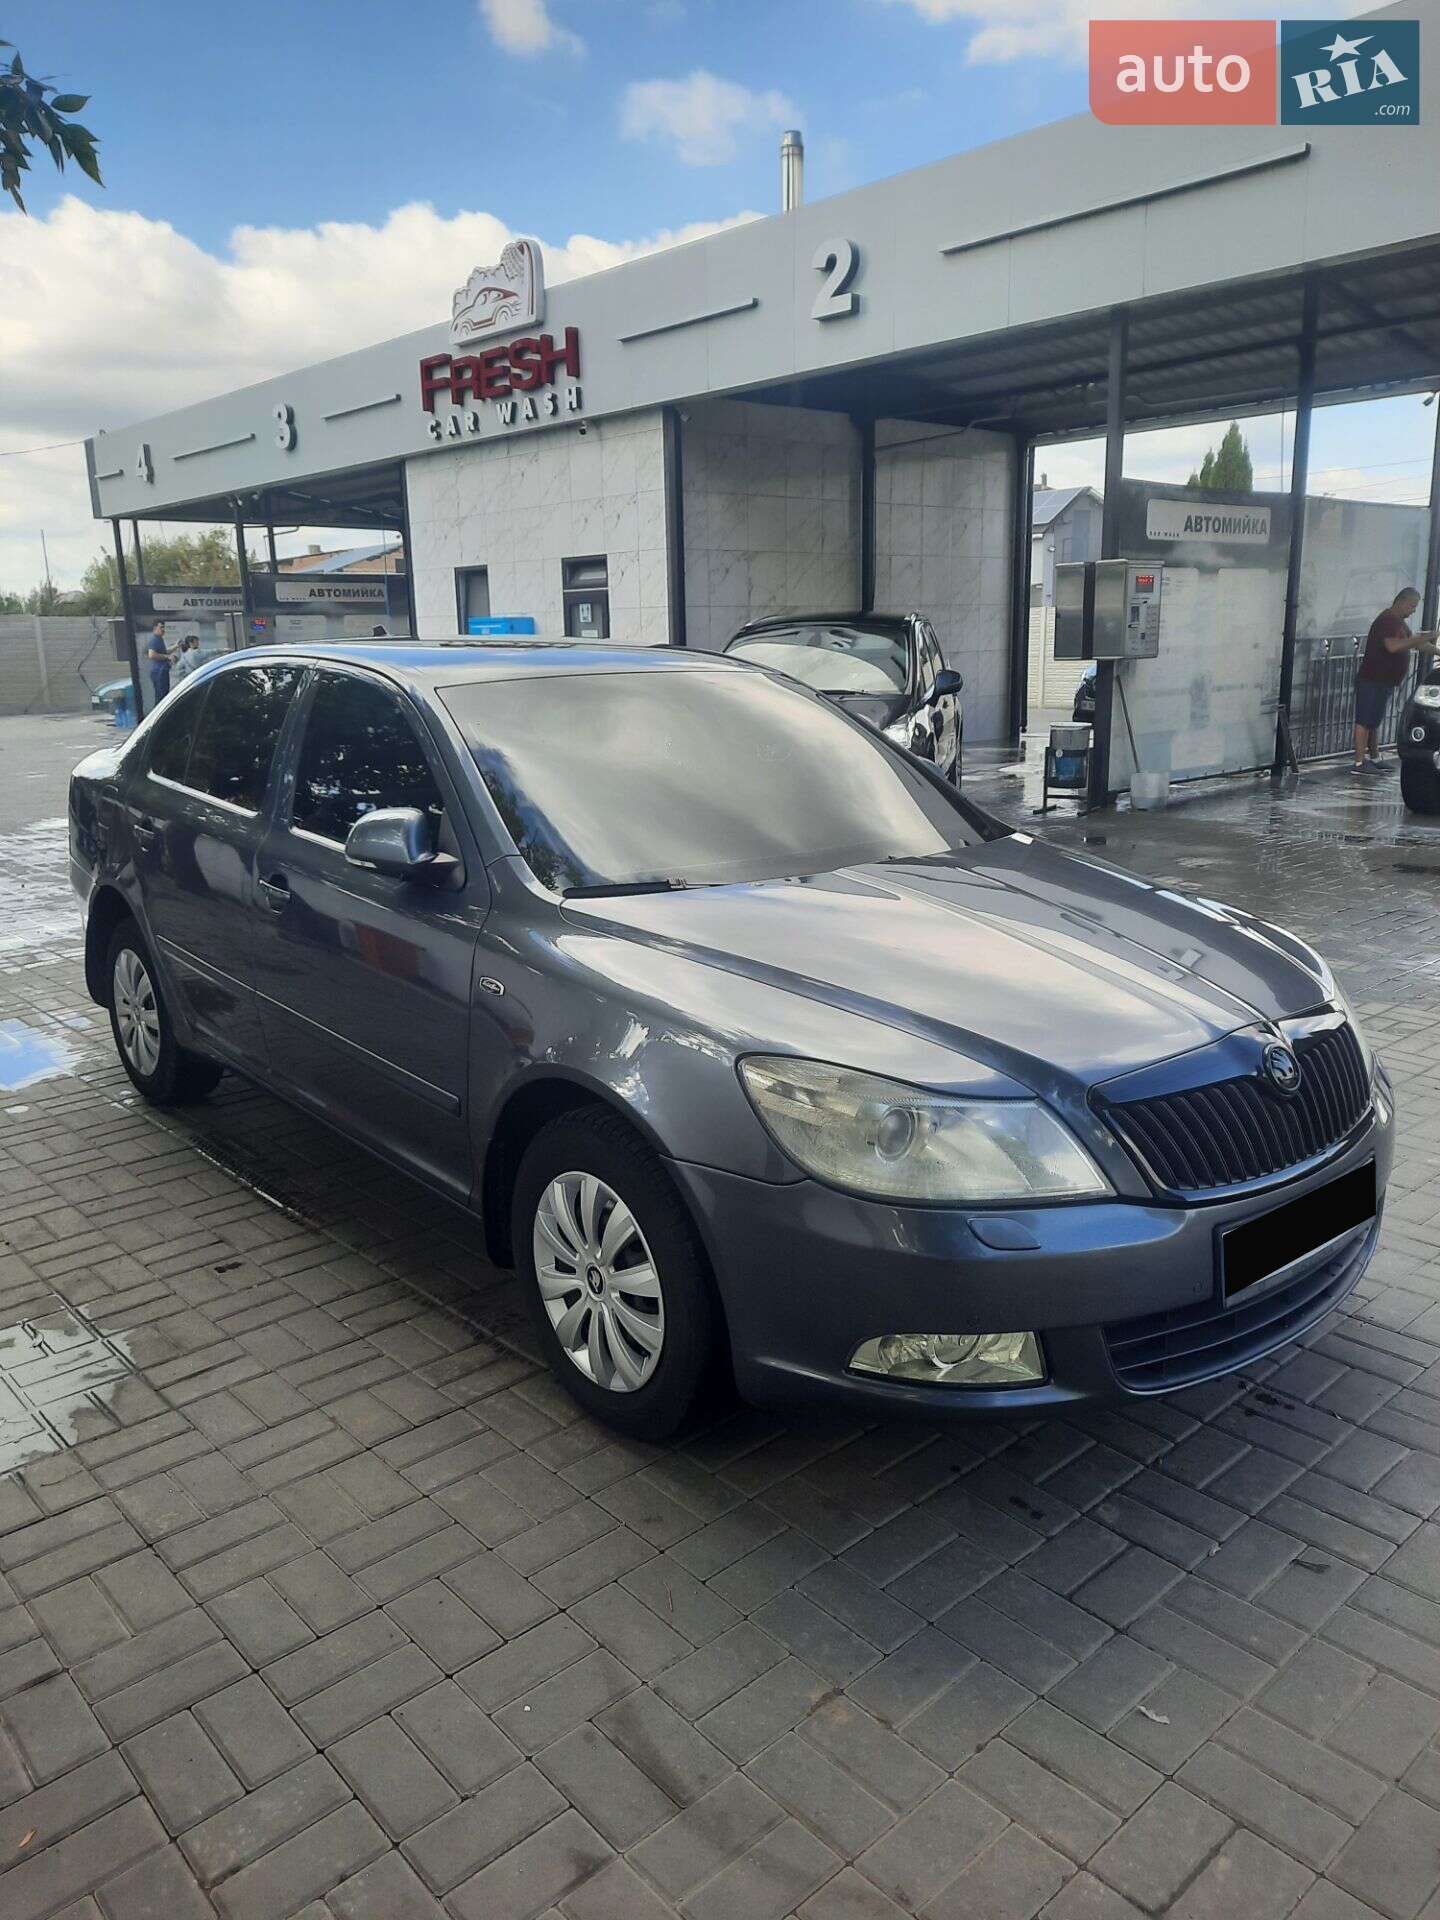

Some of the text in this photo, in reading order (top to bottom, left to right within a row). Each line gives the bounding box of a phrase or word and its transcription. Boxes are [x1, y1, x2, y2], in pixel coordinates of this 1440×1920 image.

[811, 238, 860, 321] 2
[420, 326, 581, 413] FRESH
[272, 401, 298, 450] 3
[427, 386, 582, 440] CAR WASH
[136, 443, 155, 484] 4
[1184, 515, 1267, 534] АВТОМИЙКА
